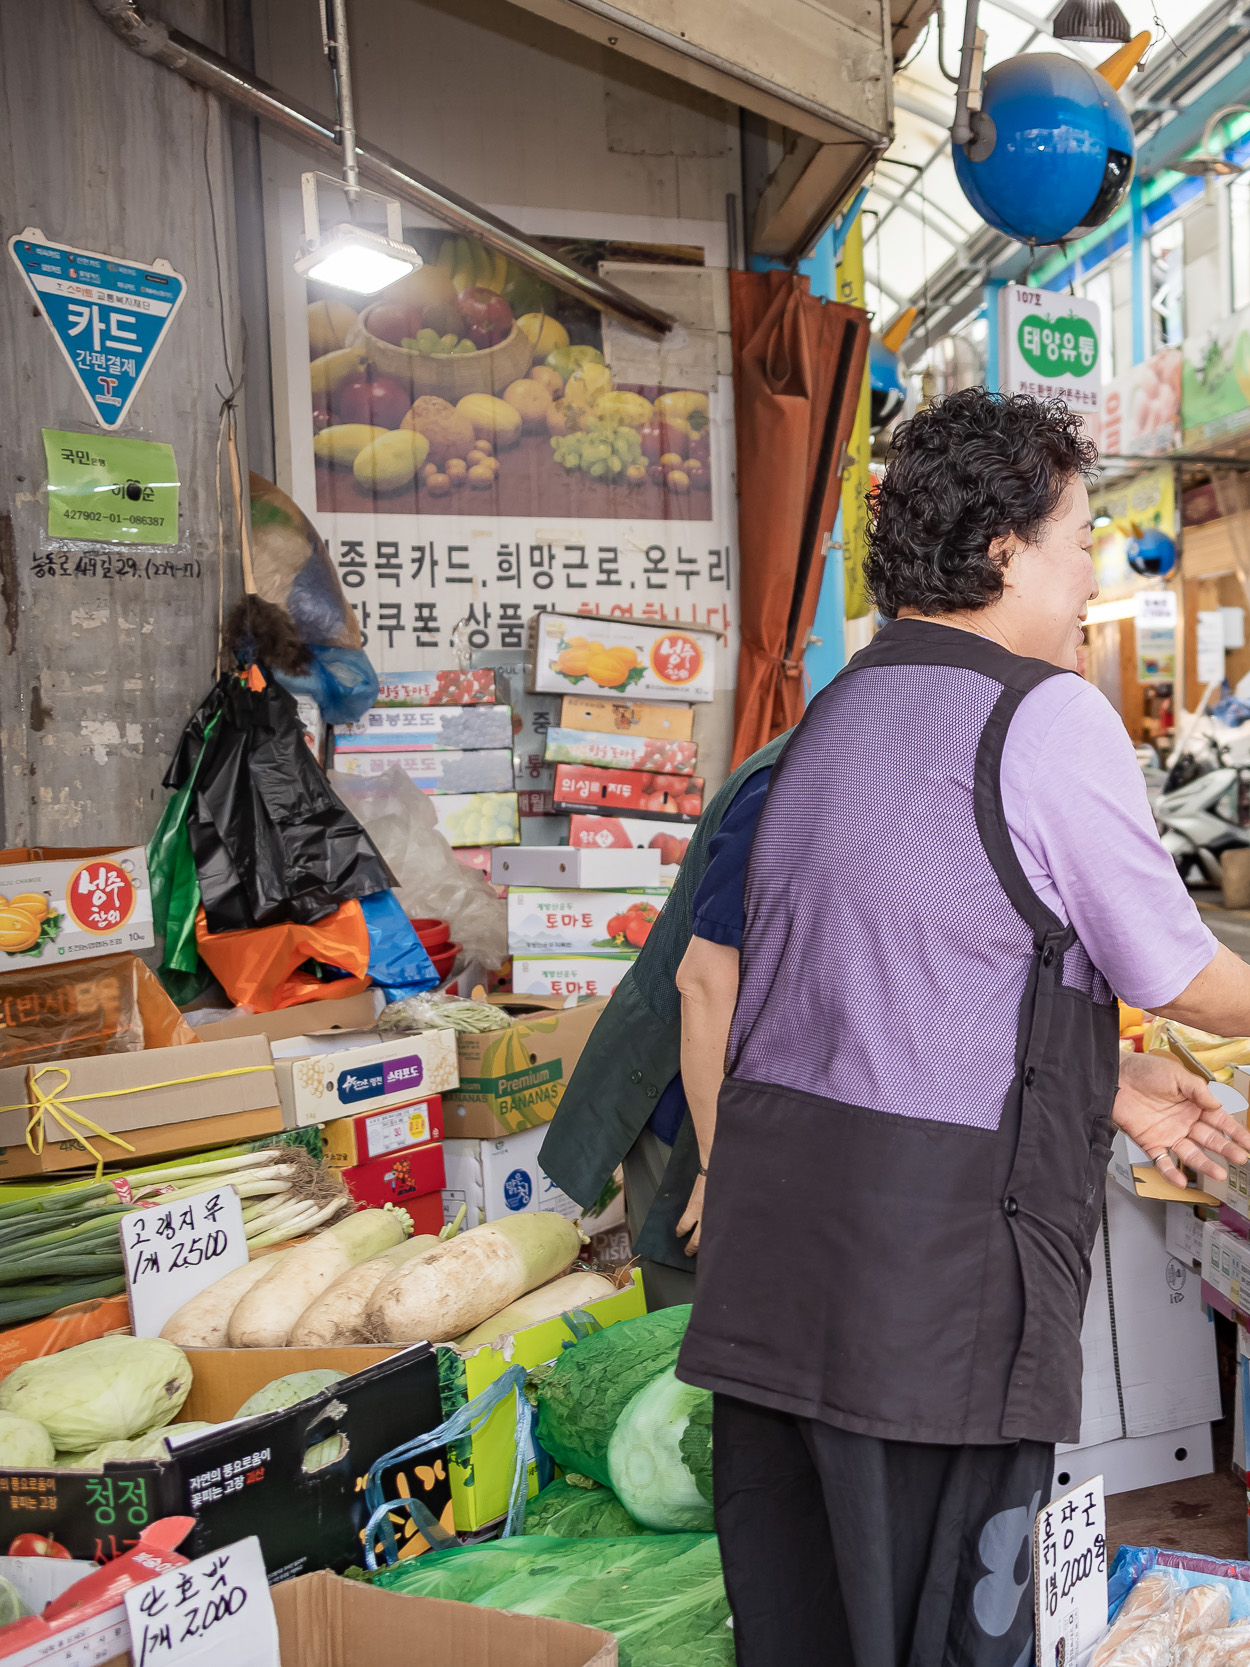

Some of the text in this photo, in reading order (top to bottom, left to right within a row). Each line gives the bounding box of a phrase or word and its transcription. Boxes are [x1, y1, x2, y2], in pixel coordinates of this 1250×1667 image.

[67, 303, 143, 353] 카드
[1023, 325, 1095, 367] 태양유통
[76, 349, 136, 378] 간편결제
[111, 479, 155, 503] 이순
[465, 601, 556, 649] 상품
[659, 638, 696, 669] 성주
[77, 866, 126, 908] 성주
[88, 907, 121, 928] 참외
[546, 912, 593, 929] 토마토
[550, 980, 598, 995] 토마토
[498, 1069, 550, 1095] Premium
[500, 1084, 559, 1116] BANANAS
[203, 1194, 225, 1223] 무
[132, 1250, 161, 1285] 1개
[190, 1447, 272, 1490] 자연의 풍요로움이
[11, 1477, 56, 1493] 풍요로움이
[191, 1486, 223, 1507] 꽃피는
[224, 1475, 245, 1496] 고장
[10, 1495, 58, 1511] 꽃피는 고장
[85, 1477, 149, 1525] 청정
[93, 1534, 140, 1565] 사
